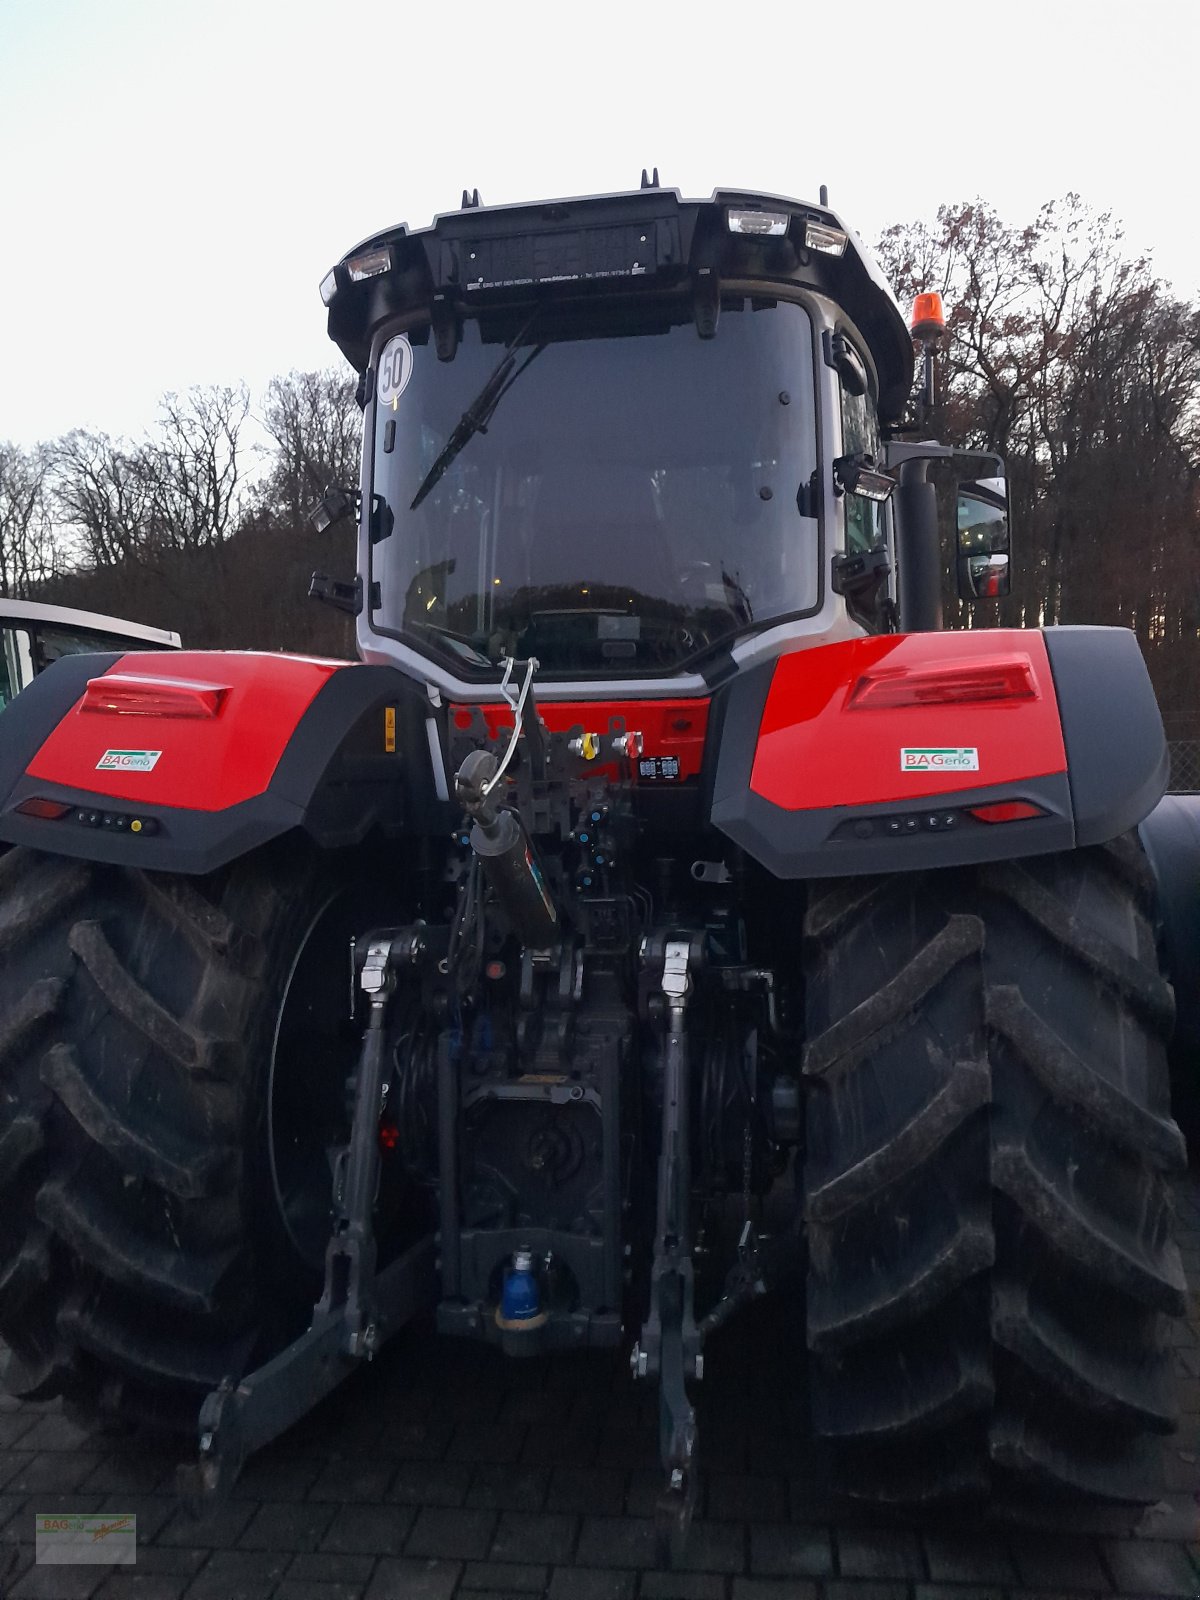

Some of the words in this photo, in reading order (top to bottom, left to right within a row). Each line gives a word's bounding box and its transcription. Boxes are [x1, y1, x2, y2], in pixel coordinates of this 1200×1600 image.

[382, 347, 404, 394] 50
[102, 755, 150, 766] BAGeno
[905, 754, 971, 766] BAGeno
